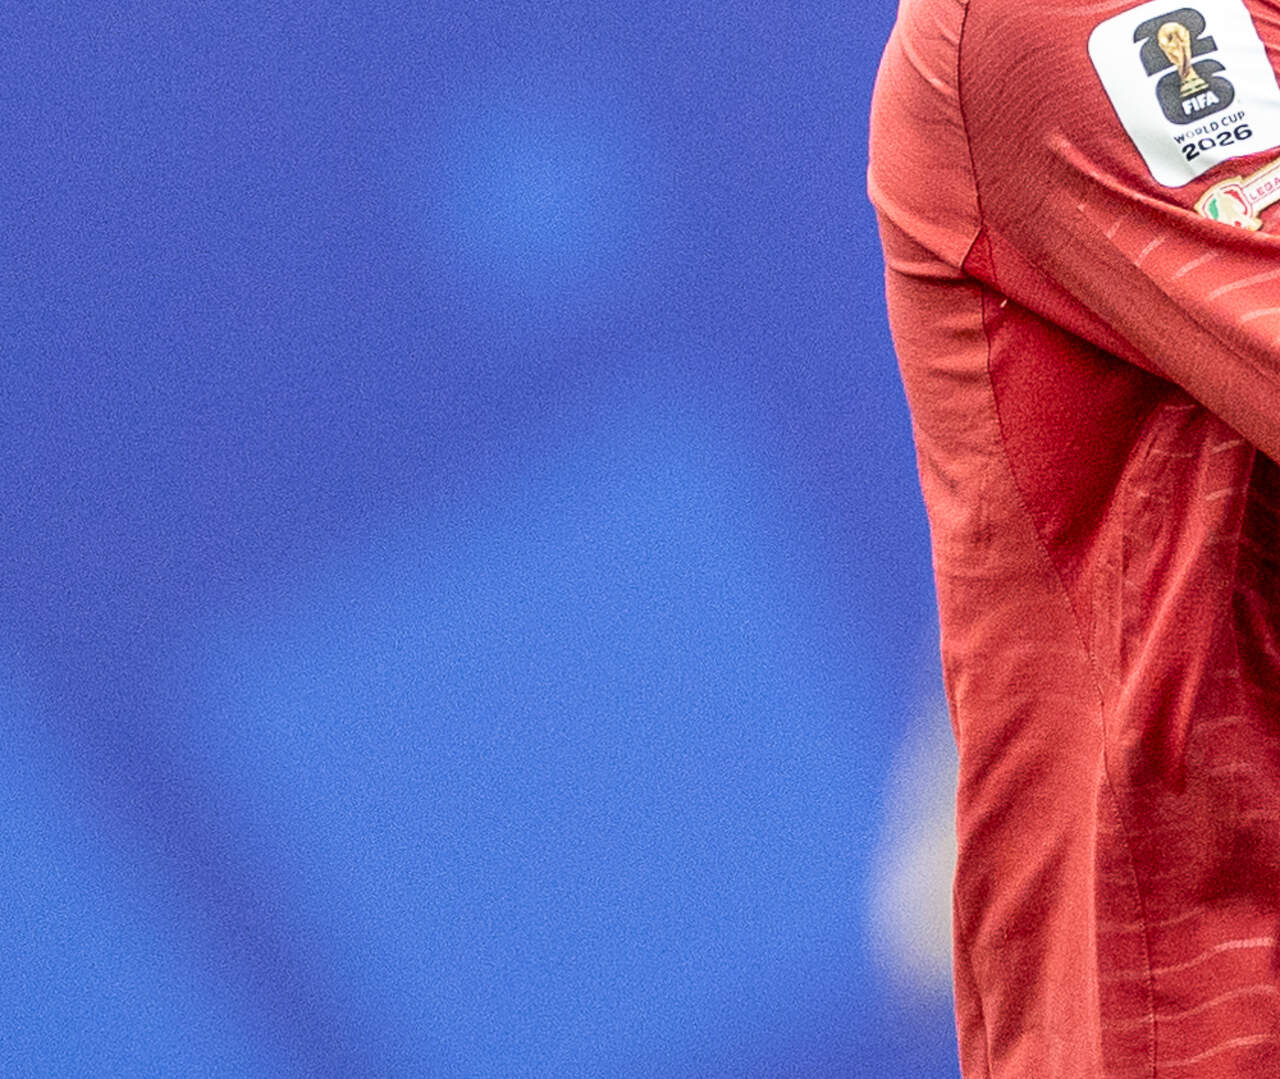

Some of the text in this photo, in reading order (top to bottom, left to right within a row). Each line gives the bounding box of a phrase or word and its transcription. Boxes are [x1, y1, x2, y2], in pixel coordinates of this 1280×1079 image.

[1182, 91, 1220, 115] FIFA
[1173, 110, 1245, 144] WORLD CUP
[1182, 124, 1253, 162] 2026
